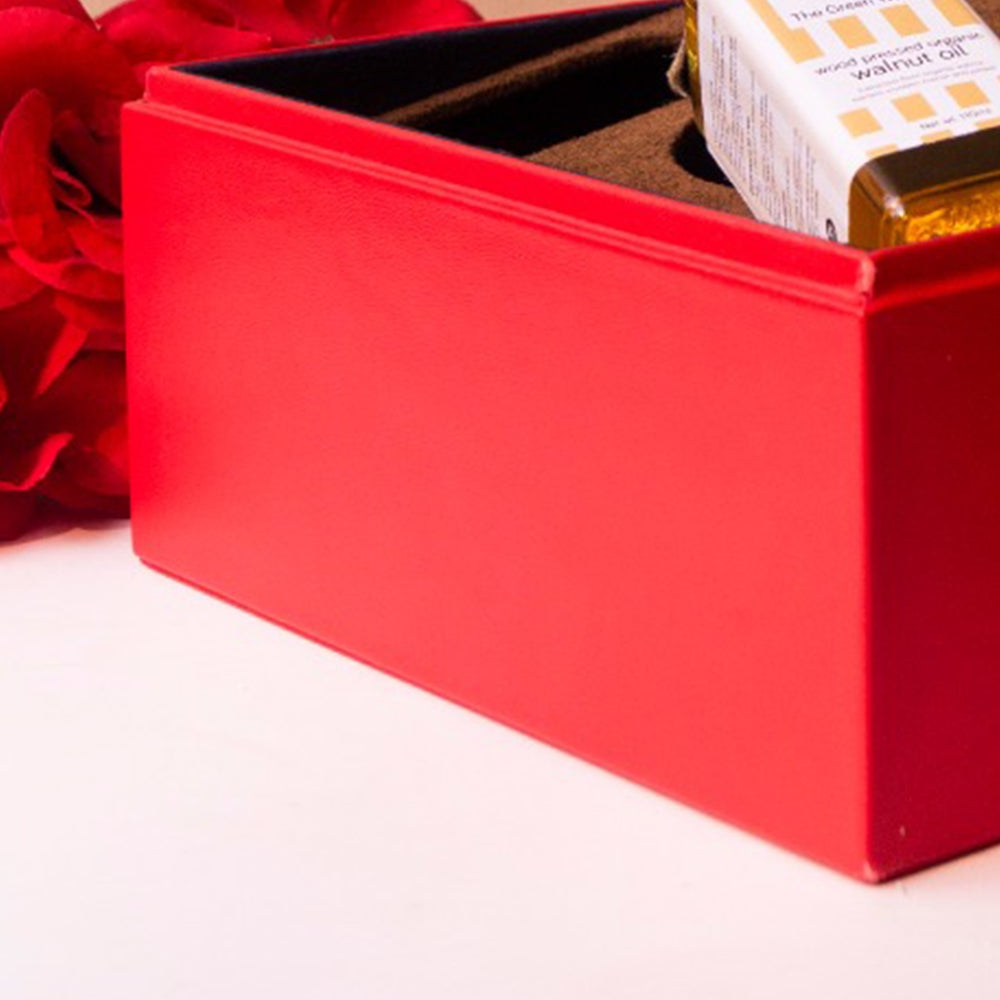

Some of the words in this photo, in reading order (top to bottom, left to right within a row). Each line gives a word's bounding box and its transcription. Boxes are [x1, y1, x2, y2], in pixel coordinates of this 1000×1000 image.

[790, 9, 823, 21] The
[814, 57, 858, 76] wood
[861, 42, 924, 65] pressed
[927, 31, 985, 49] organic
[850, 51, 934, 81] walnut
[938, 44, 969, 61] oil
